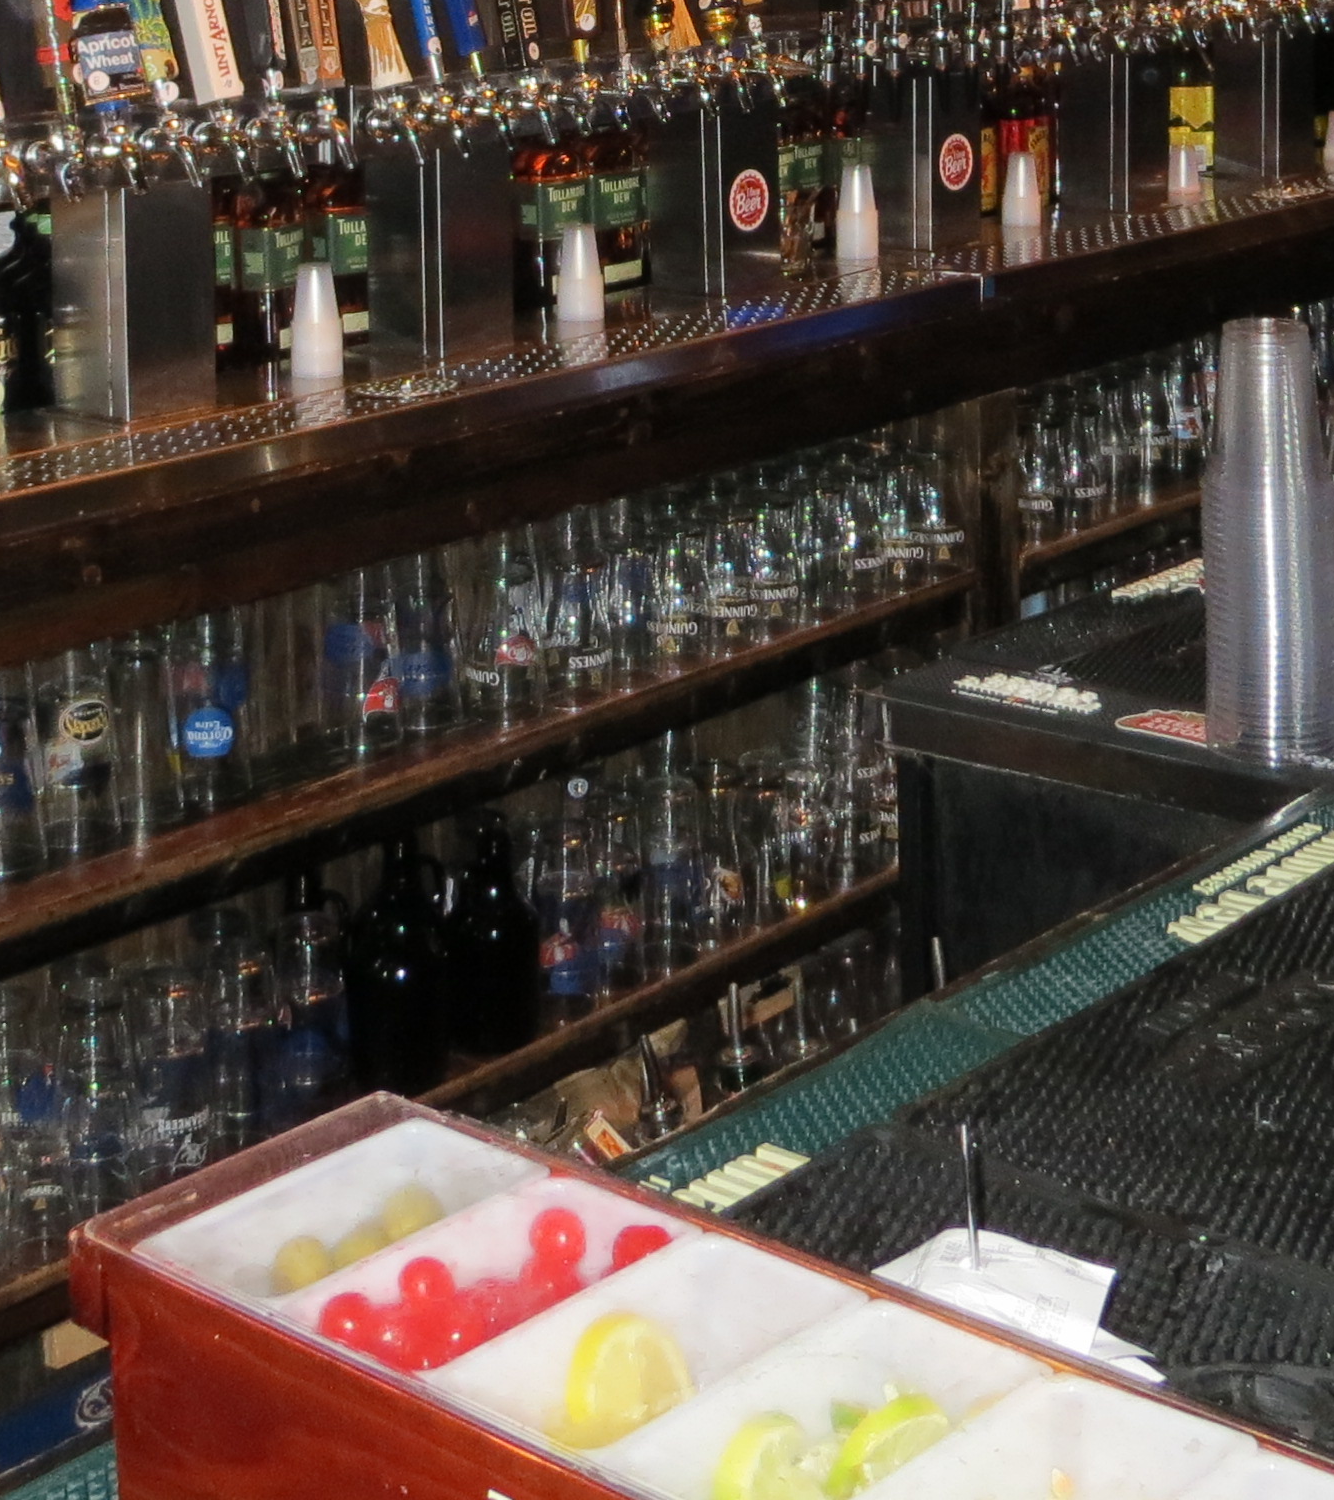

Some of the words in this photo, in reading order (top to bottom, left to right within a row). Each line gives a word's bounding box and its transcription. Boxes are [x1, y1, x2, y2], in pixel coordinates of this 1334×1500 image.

[77, 33, 136, 56] Apricot
[85, 53, 135, 70] Wheat
[598, 176, 641, 195] TULLAMORE
[613, 191, 631, 206] DEW
